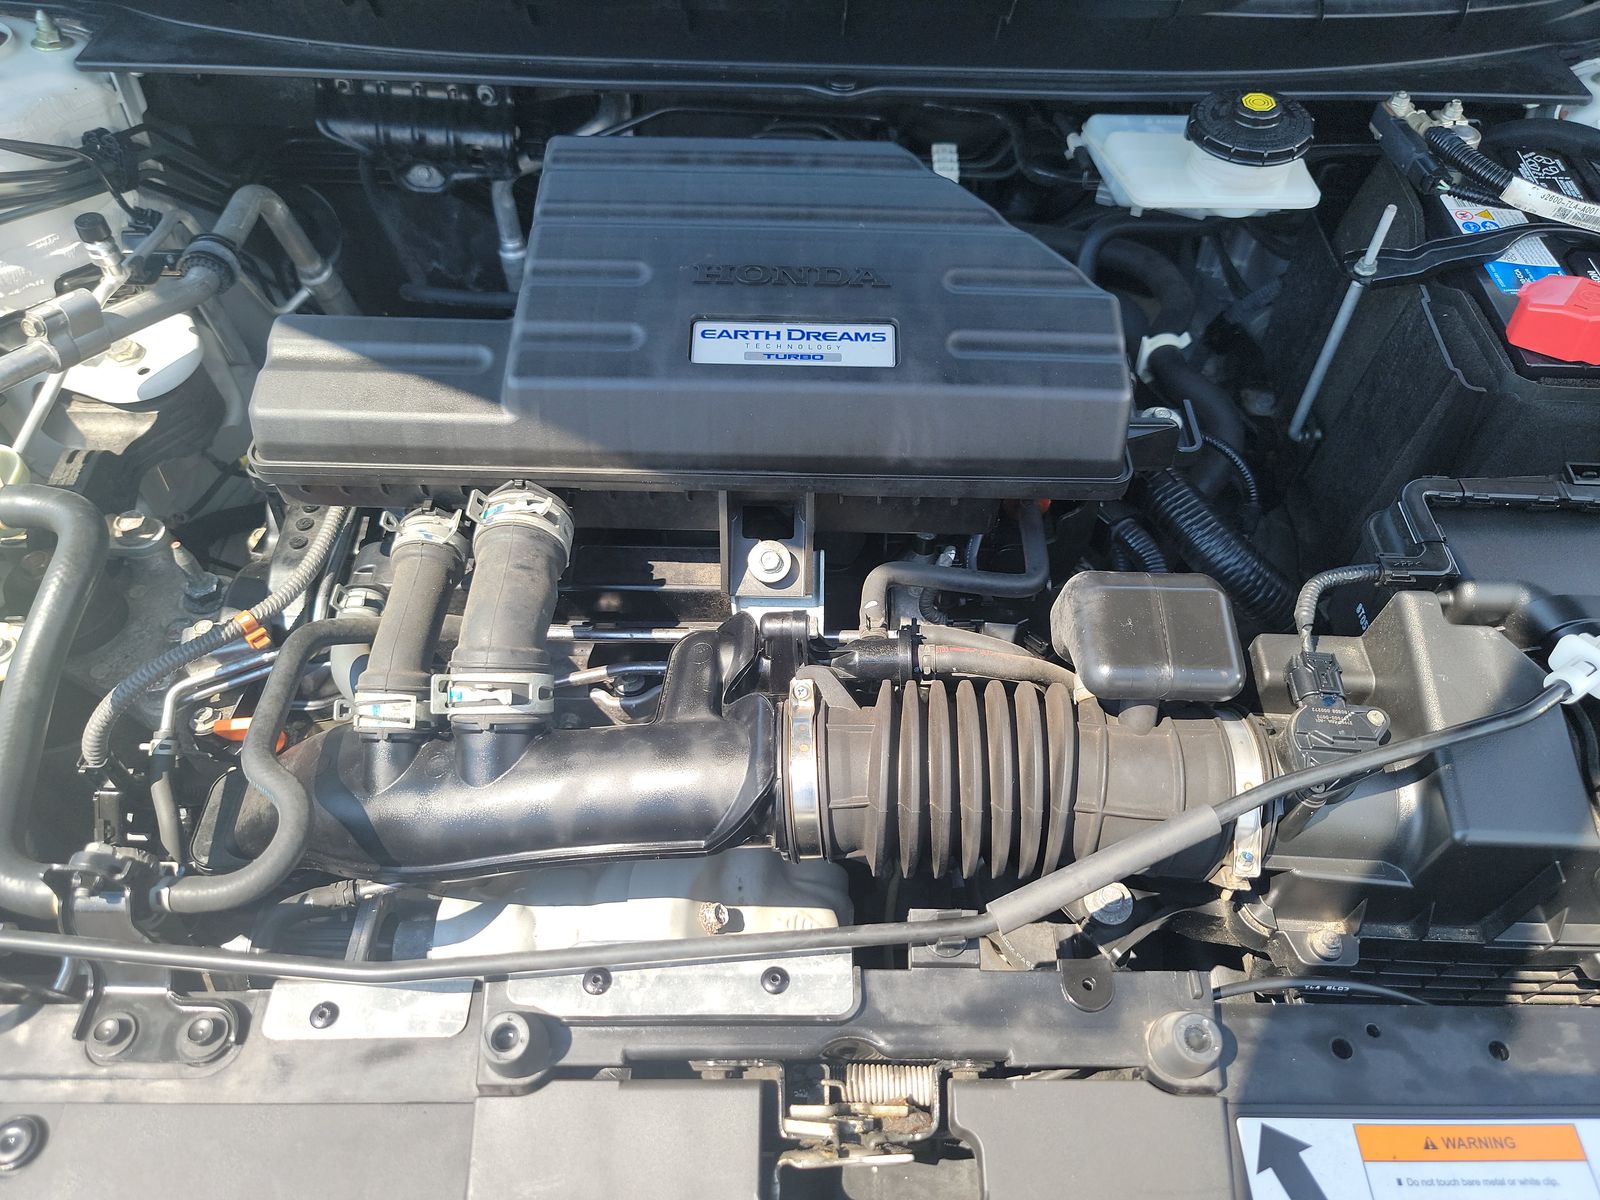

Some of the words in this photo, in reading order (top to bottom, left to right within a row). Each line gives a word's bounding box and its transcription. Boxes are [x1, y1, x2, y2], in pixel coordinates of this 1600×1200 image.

[692, 263, 891, 288] HONDA
[700, 329, 781, 341] EARTH
[787, 328, 887, 343] DREAMS
[745, 342, 842, 351] TECHNOLOGY
[763, 353, 824, 361] TURBO
[1442, 1136, 1517, 1150] WARNING
[1406, 1177, 1420, 1187] Do
[1421, 1177, 1434, 1187] not
[1436, 1177, 1460, 1187] touch
[1462, 1177, 1481, 1187] bare
[1482, 1177, 1506, 1187] metal
[1507, 1178, 1517, 1187] or
